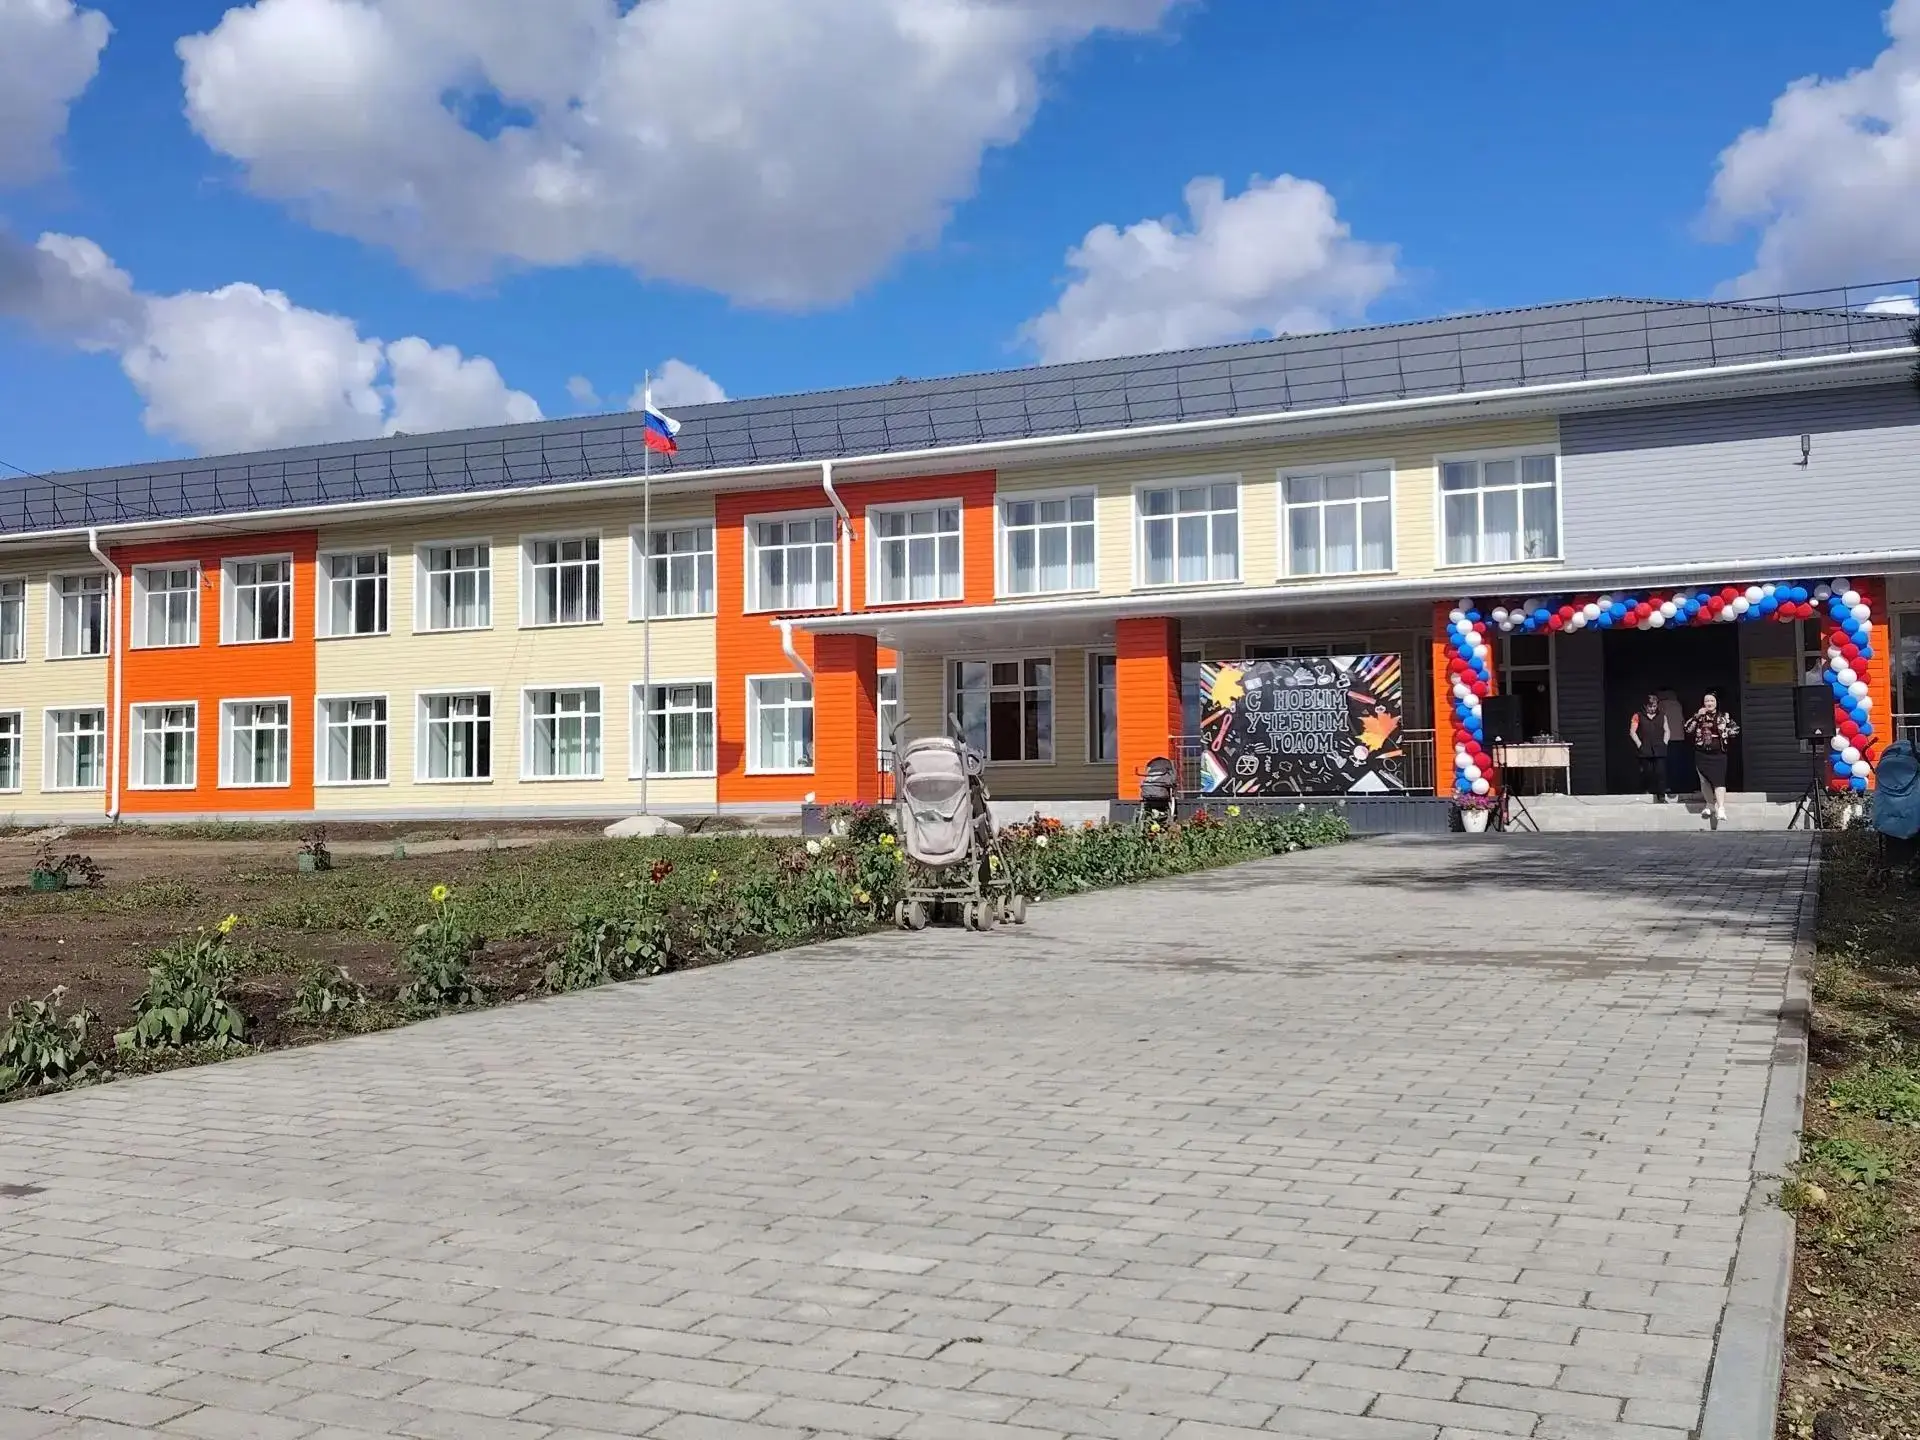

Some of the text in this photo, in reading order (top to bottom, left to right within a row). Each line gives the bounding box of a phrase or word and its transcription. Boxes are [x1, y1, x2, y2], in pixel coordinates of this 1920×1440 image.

[1245, 688, 1348, 711] С НОВЫМ
[1245, 710, 1349, 733] УЧЕБНЫМ
[1268, 732, 1334, 754] ГОДОМ
